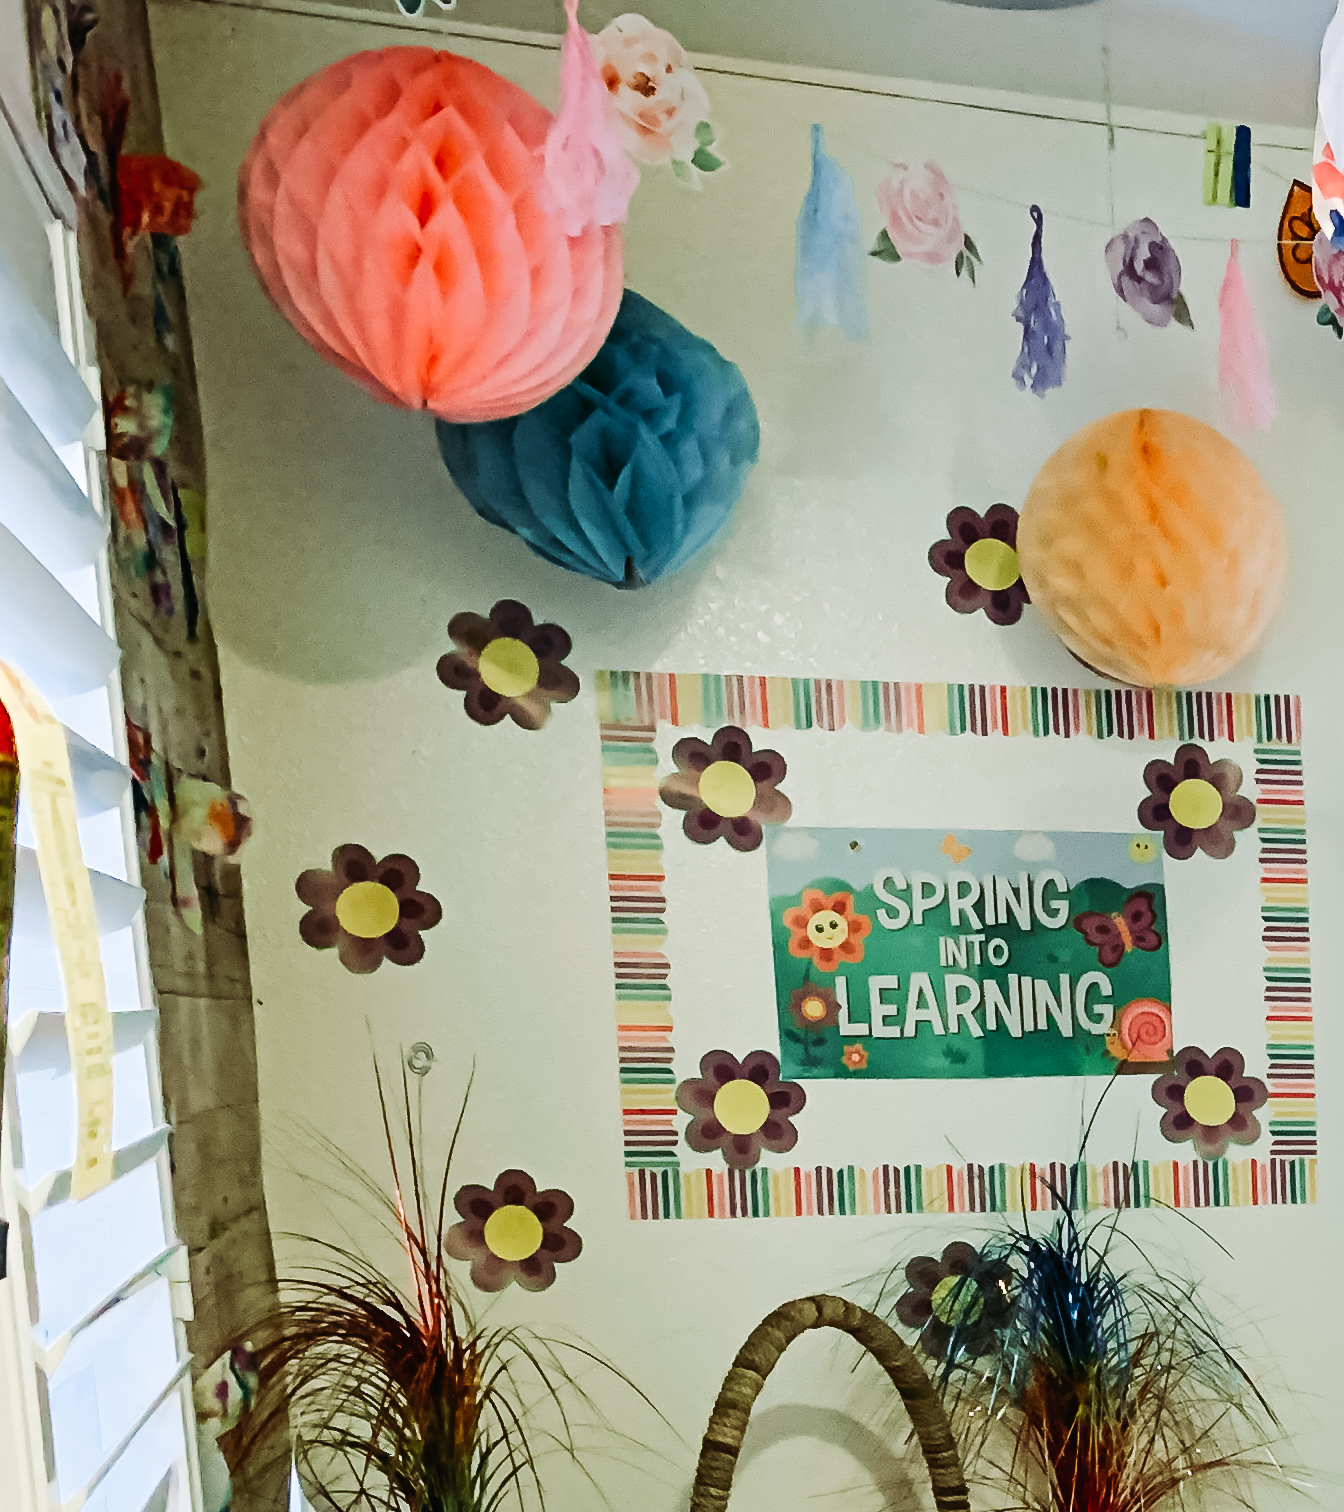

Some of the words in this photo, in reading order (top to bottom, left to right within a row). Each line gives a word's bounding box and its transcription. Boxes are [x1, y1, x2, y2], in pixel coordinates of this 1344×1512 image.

[873, 869, 1071, 932] SPRING
[938, 934, 1010, 968] INTO
[834, 970, 1115, 1040] LEARNING
